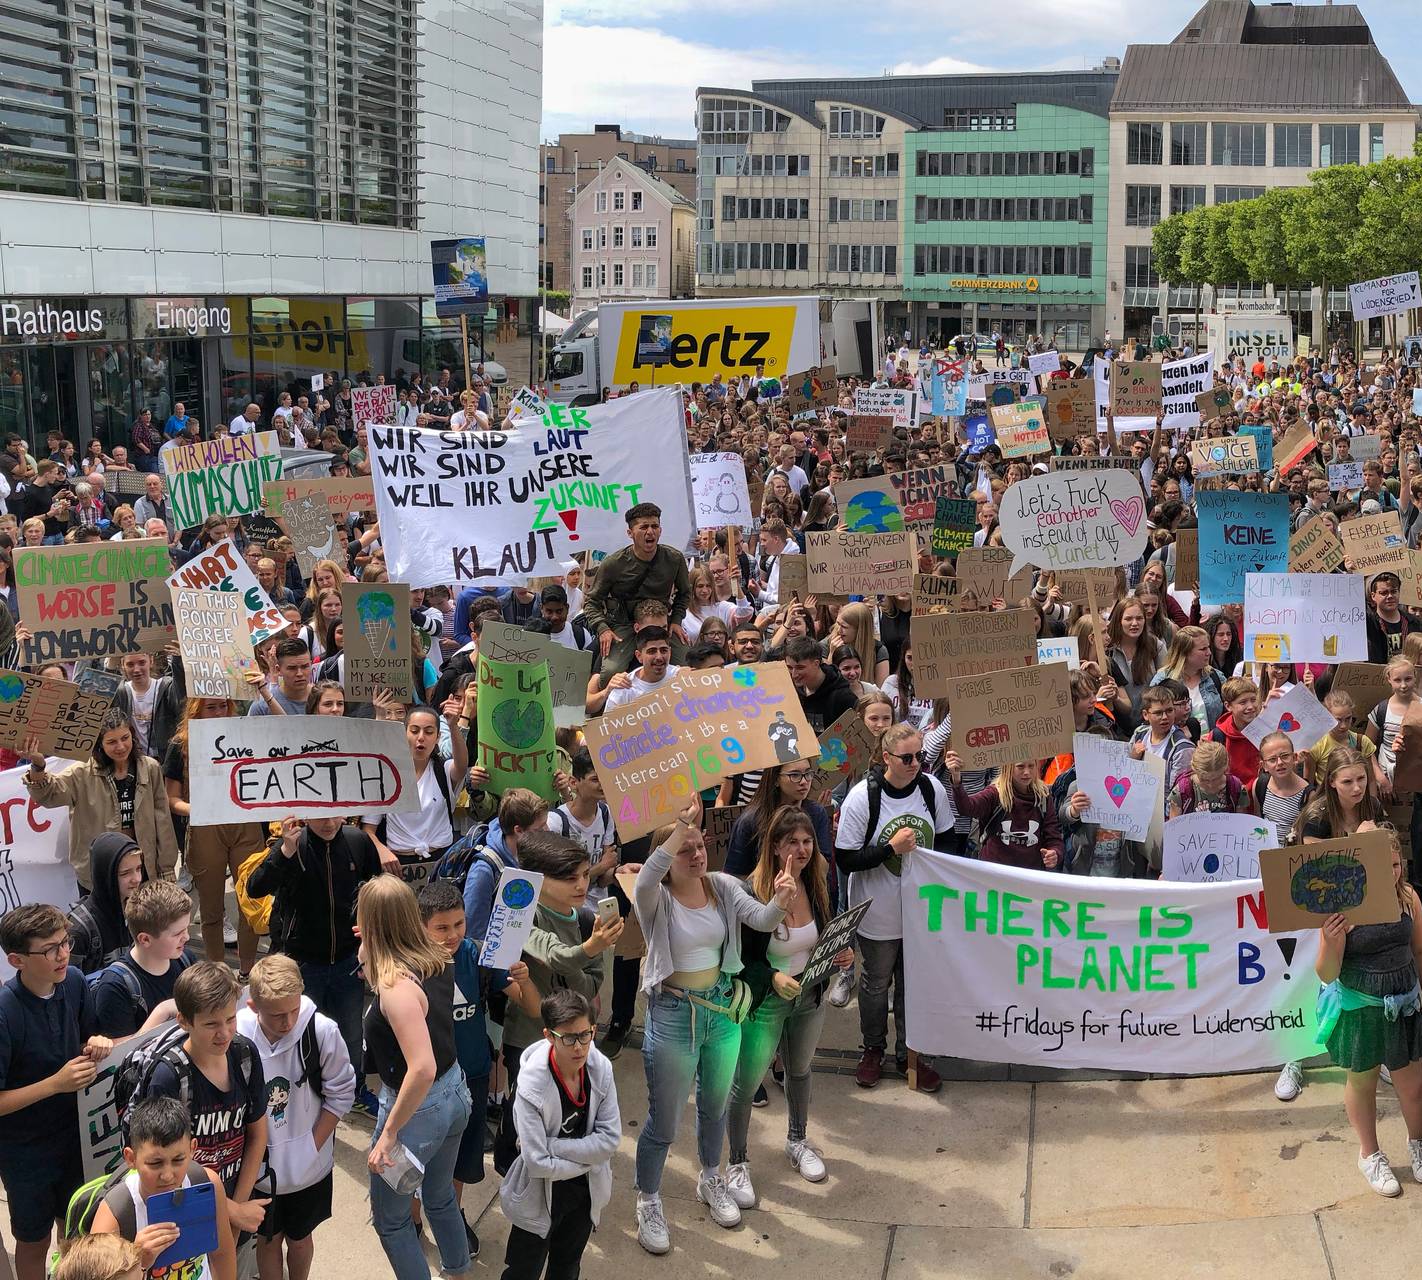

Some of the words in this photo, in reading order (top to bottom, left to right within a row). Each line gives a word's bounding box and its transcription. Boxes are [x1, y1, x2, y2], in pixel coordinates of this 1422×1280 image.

[950, 280, 1024, 290] COMMERZBANK
[1238, 300, 1275, 311] Krombacher
[2, 303, 103, 335] Rathaus
[156, 301, 232, 335] Eingang
[633, 324, 772, 370] ertz
[1229, 329, 1289, 347] INSEL
[1230, 347, 1254, 357] AUF
[1257, 347, 1289, 357] TOUR
[993, 371, 1007, 380] ES
[1119, 365, 1130, 377] TO
[1188, 360, 1210, 375] hat
[1116, 386, 1130, 395] TO
[1132, 377, 1145, 386] OR
[371, 427, 427, 453] WIR
[440, 430, 509, 452] SIND
[1014, 429, 1047, 443] HOTTER
[171, 443, 204, 472] WIR
[203, 436, 258, 468] WOLLEN
[377, 453, 426, 480] WIR
[437, 453, 507, 480] SIND
[533, 429, 590, 456] LAUT
[1197, 441, 1251, 462] VOICE
[1054, 458, 1089, 471] WENN
[1090, 459, 1111, 470] IHR
[386, 483, 454, 509] WEIL
[464, 480, 503, 508] IHR
[509, 452, 600, 505] UNSERE
[889, 465, 945, 490] WENN
[165, 454, 285, 531] KLIMASCHUTZ
[1017, 484, 1062, 519] Let's
[1064, 477, 1112, 505] Fuck
[531, 479, 644, 531] ZUKUNFT
[935, 510, 973, 525] CHANGE
[808, 534, 832, 548] WIR
[933, 528, 974, 544] CLIMATE
[1022, 524, 1073, 550] instead
[1076, 520, 1088, 548] of
[1223, 524, 1277, 546] KEINE
[1290, 524, 1323, 556] DINO'S
[1348, 521, 1393, 542] EISPOLE
[843, 547, 872, 560] NICHT,
[932, 536, 973, 552] CHANGE
[1315, 541, 1334, 560] auch
[17, 552, 92, 586] CLIMATE
[90, 545, 171, 581] CHANGE
[171, 542, 239, 589] WHAT
[809, 563, 828, 574] WIR
[1356, 551, 1405, 570] BRAUNKOHLE
[832, 576, 913, 594] KLIMAWANDEL
[920, 577, 958, 596] KLIMA
[1247, 577, 1293, 600] KLIMA
[1322, 575, 1362, 599] BIER
[37, 583, 117, 622] WORSE
[130, 579, 149, 605] IS
[177, 591, 198, 607] AT
[203, 592, 239, 610] THIS
[915, 595, 953, 606] POLITIK
[118, 602, 176, 632] THAN
[180, 608, 228, 627] POINT
[232, 611, 240, 626] I
[1248, 606, 1297, 626] warm
[1318, 607, 1366, 627] scheiße
[23, 623, 142, 664] HOMEWORK
[181, 624, 235, 643] AGREE
[182, 642, 221, 659] WITH
[186, 660, 228, 676] THA-
[350, 658, 373, 669] IT'S
[373, 658, 385, 669] SO
[386, 657, 408, 668] HOT
[480, 662, 504, 690] Die
[955, 677, 994, 700] MAKE
[1010, 670, 1042, 688] THE
[193, 678, 232, 699] NOS!
[13, 677, 43, 725] getting
[674, 685, 786, 724] change
[987, 693, 1037, 717] WORLD
[50, 702, 69, 733] than
[54, 690, 90, 751] HARRY
[75, 699, 109, 751] STYLES
[965, 723, 1011, 748] GRETA
[1016, 715, 1064, 739] AGAIN
[211, 735, 255, 761] Save
[268, 745, 291, 760] our
[238, 760, 386, 804] EARTH
[906, 816, 923, 829] FOR
[1177, 833, 1221, 855] SAVE
[1224, 833, 1258, 853] THE
[1181, 852, 1261, 880] WORLD
[918, 884, 1108, 942] THERE
[1139, 905, 1193, 940] IS
[809, 929, 856, 966] BEFORE
[1016, 943, 1211, 993] PLANET
[975, 1005, 1076, 1053] #fridays
[1079, 1009, 1108, 1038] for
[1117, 1010, 1182, 1044] future
[1193, 1007, 1306, 1036] Lüdenscheid
